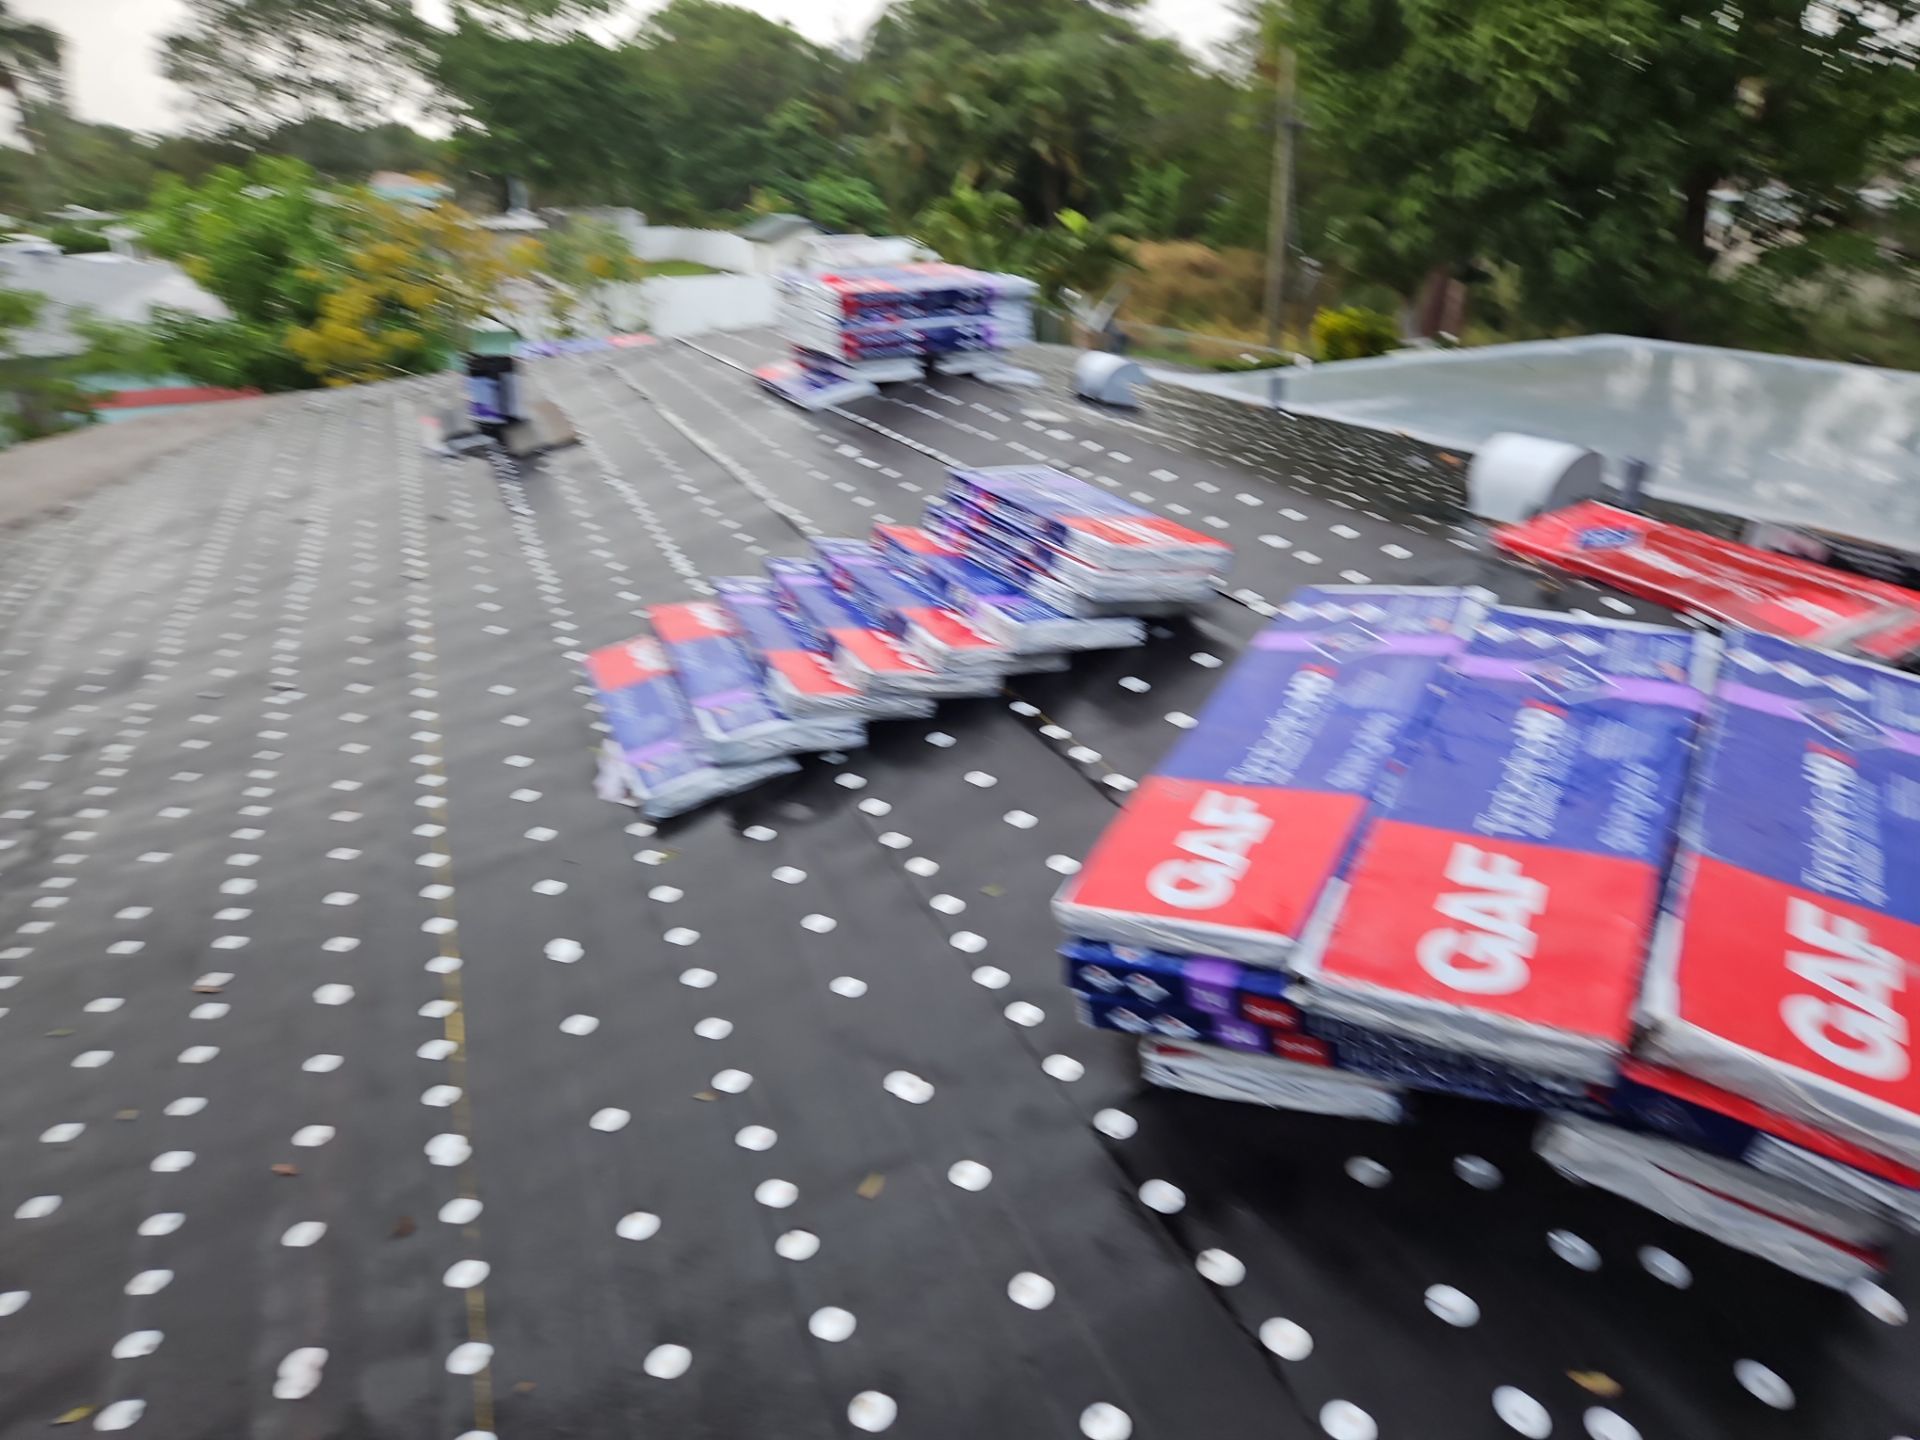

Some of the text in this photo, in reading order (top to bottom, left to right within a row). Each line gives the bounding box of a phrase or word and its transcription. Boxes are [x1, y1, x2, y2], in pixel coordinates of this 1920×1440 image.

[1147, 791, 1273, 909] GAF
[1416, 843, 1549, 995] GAF
[1779, 896, 1910, 1081] GAF
